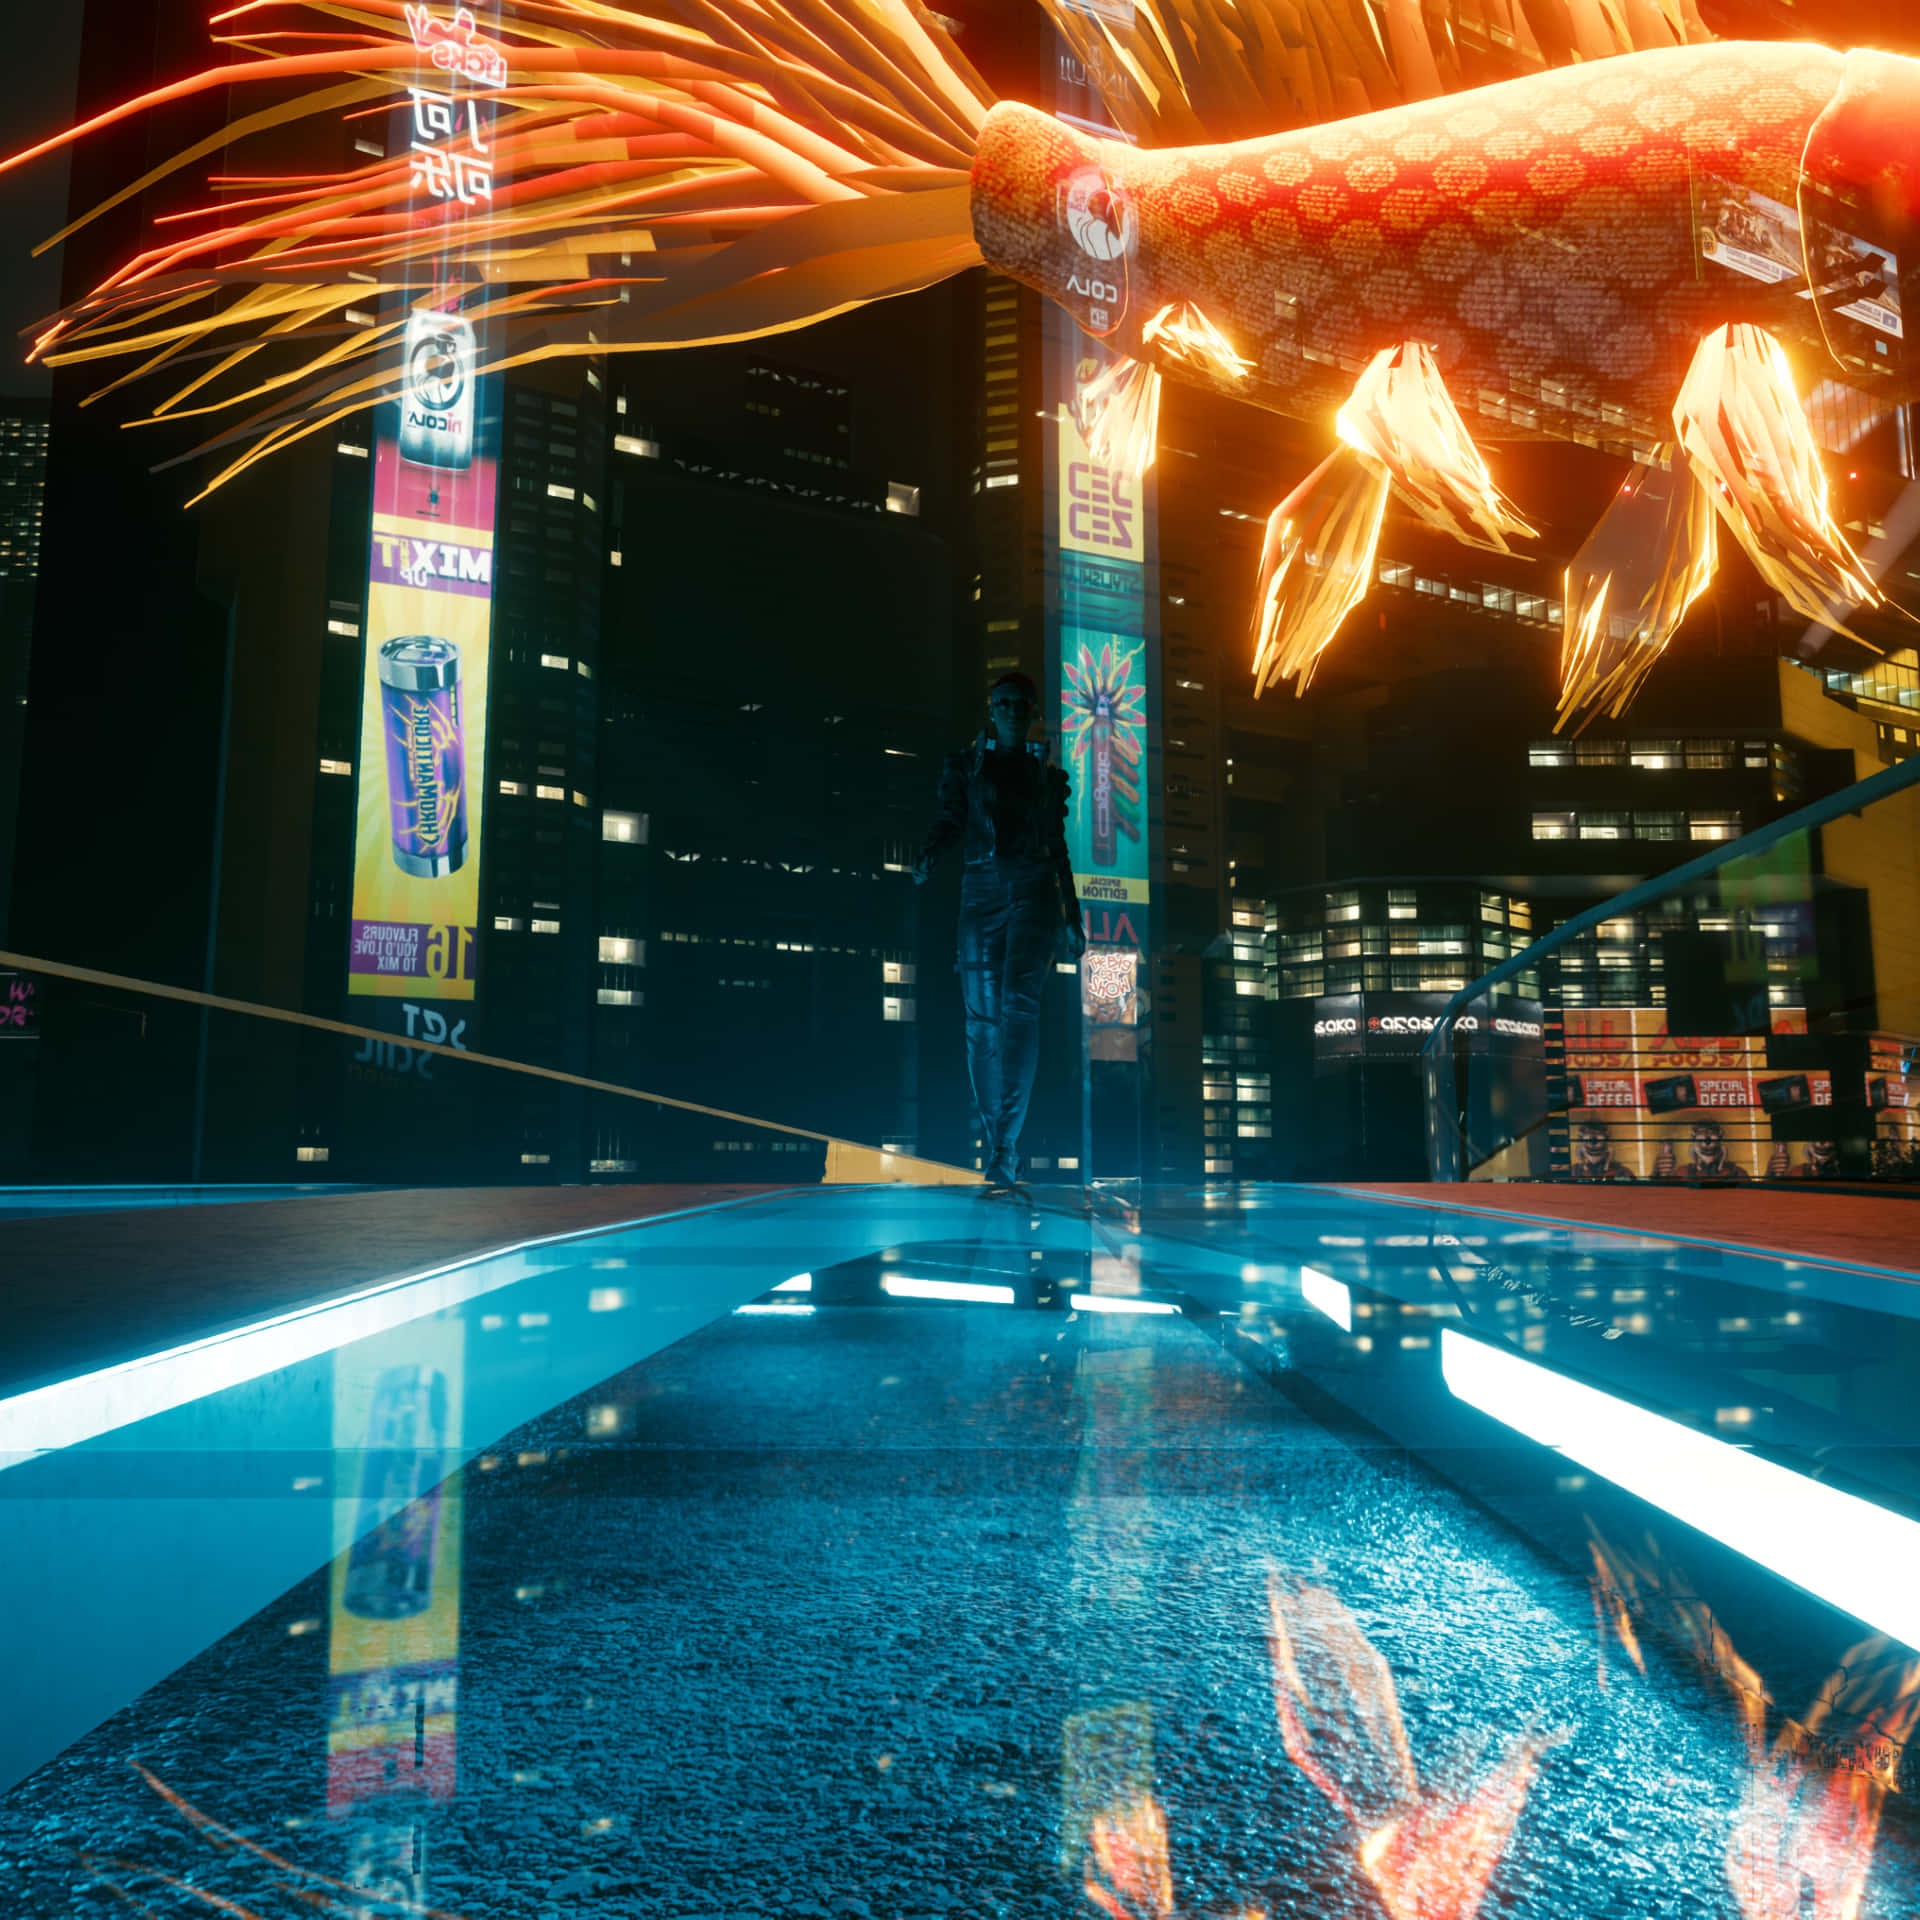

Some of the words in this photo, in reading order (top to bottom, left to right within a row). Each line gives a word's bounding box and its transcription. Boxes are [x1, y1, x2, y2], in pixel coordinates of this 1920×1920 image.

[1699, 1079, 1746, 1092] SPECIAL
[1586, 1092, 1634, 1107] OFFER
[1699, 1092, 1748, 1106] OFFER
